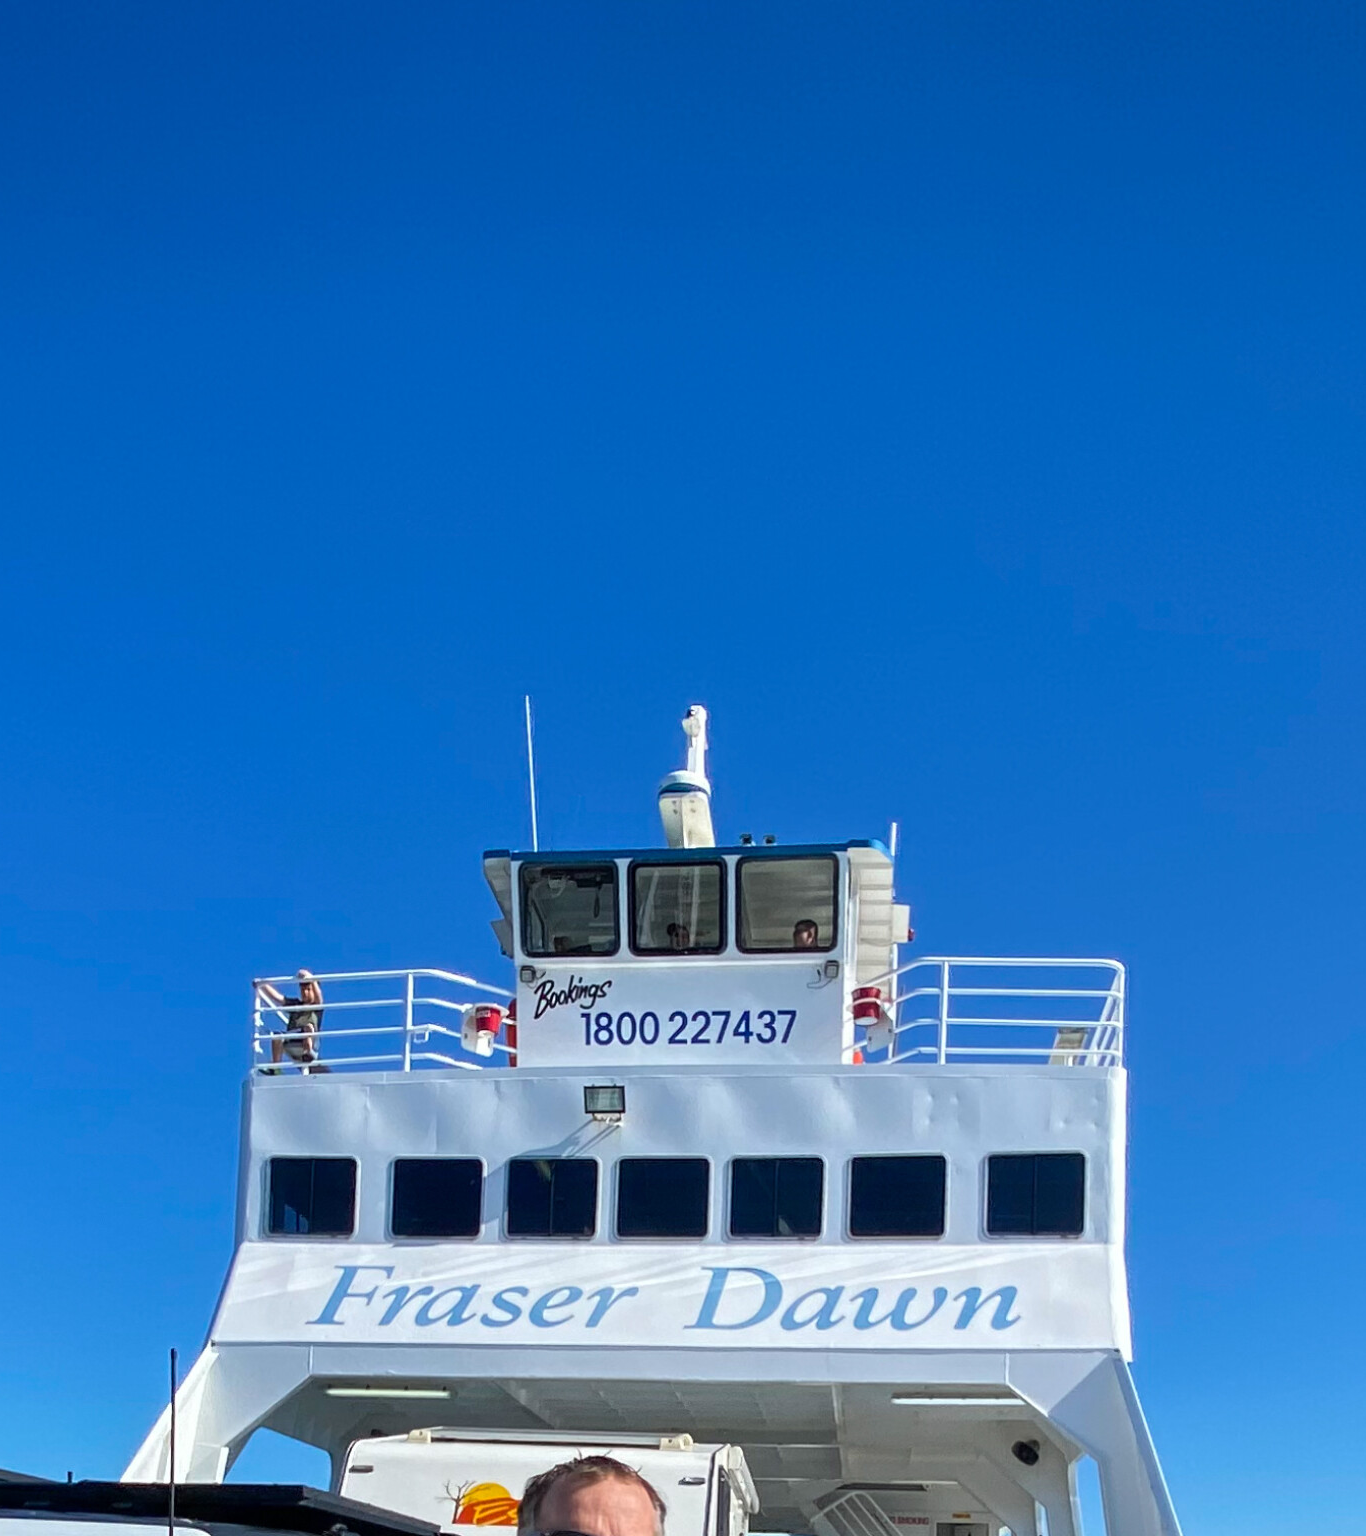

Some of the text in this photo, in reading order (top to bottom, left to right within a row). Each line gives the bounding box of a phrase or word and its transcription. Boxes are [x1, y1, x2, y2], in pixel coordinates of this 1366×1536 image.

[534, 975, 612, 1019] Bookings
[581, 1010, 796, 1046] 1800 227437
[306, 1264, 1022, 1331] Fraser Dawn
